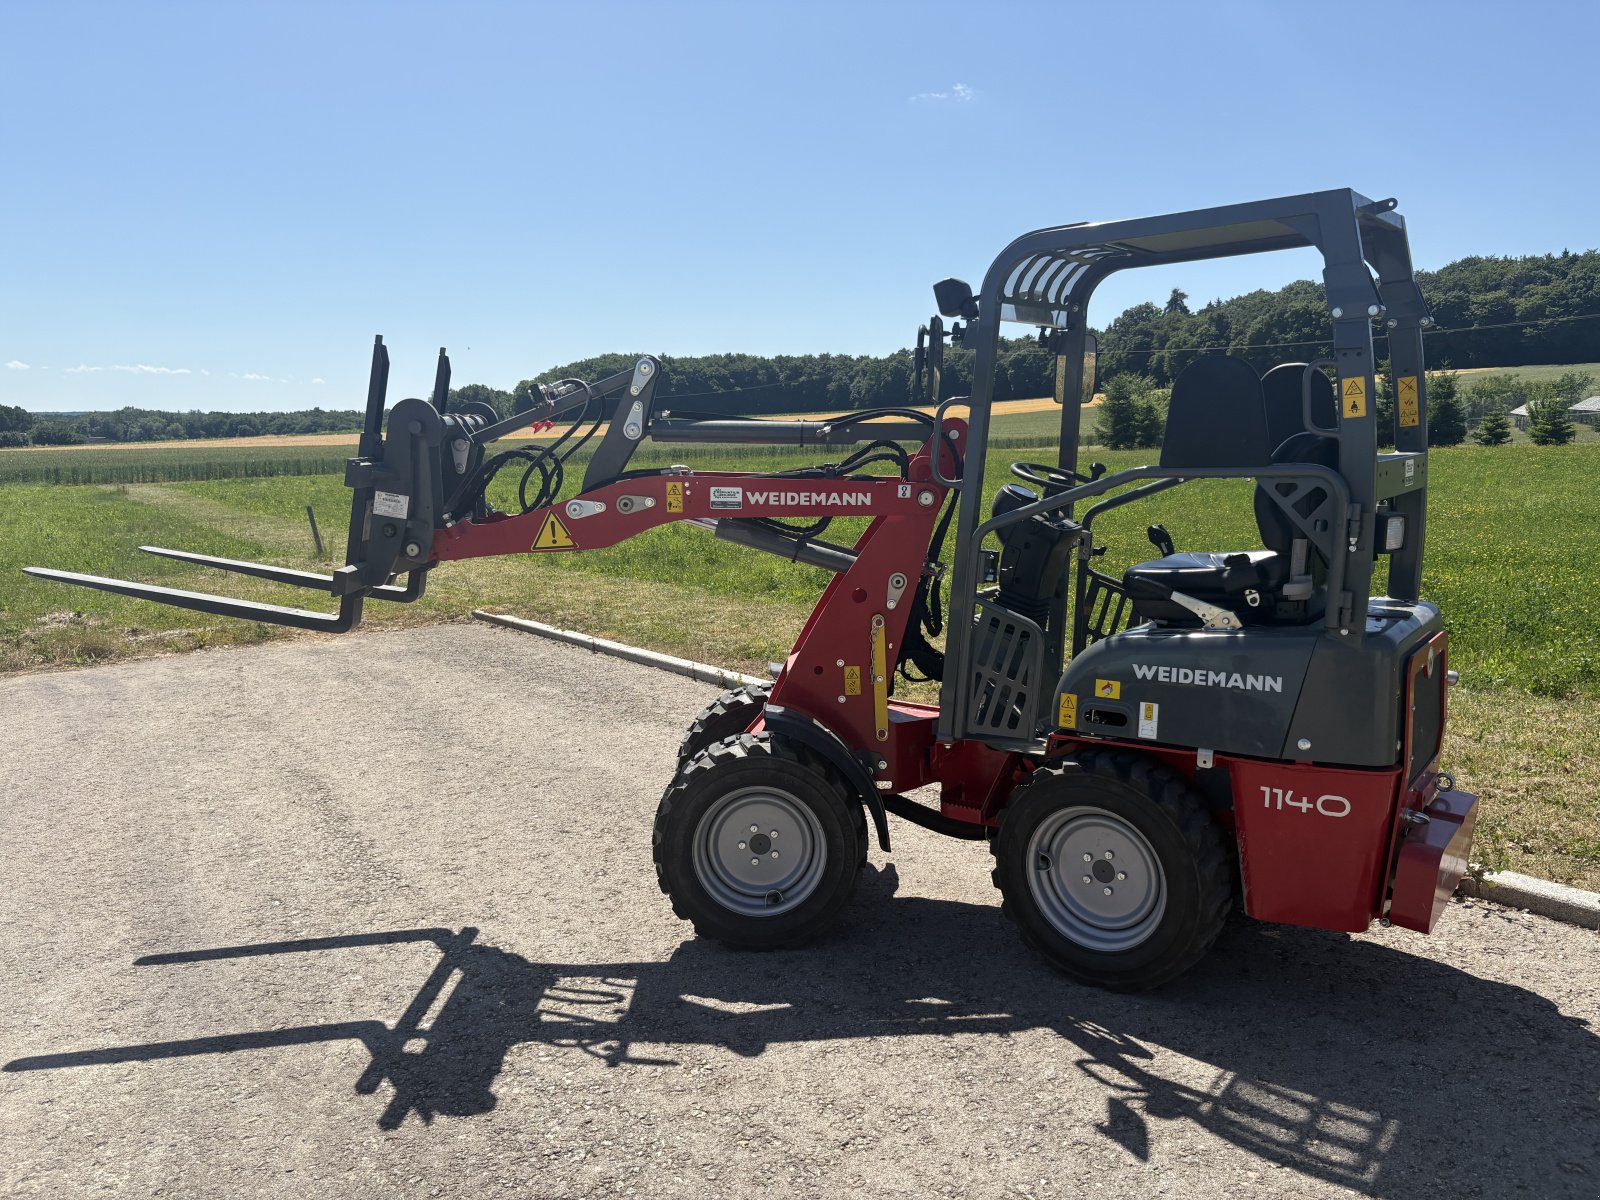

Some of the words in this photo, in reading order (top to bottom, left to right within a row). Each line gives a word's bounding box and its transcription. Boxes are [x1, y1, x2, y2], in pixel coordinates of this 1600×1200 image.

[746, 492, 872, 506] WEIDEMANN
[1132, 663, 1283, 693] WEIDEMANN
[1260, 786, 1351, 818] 1140
